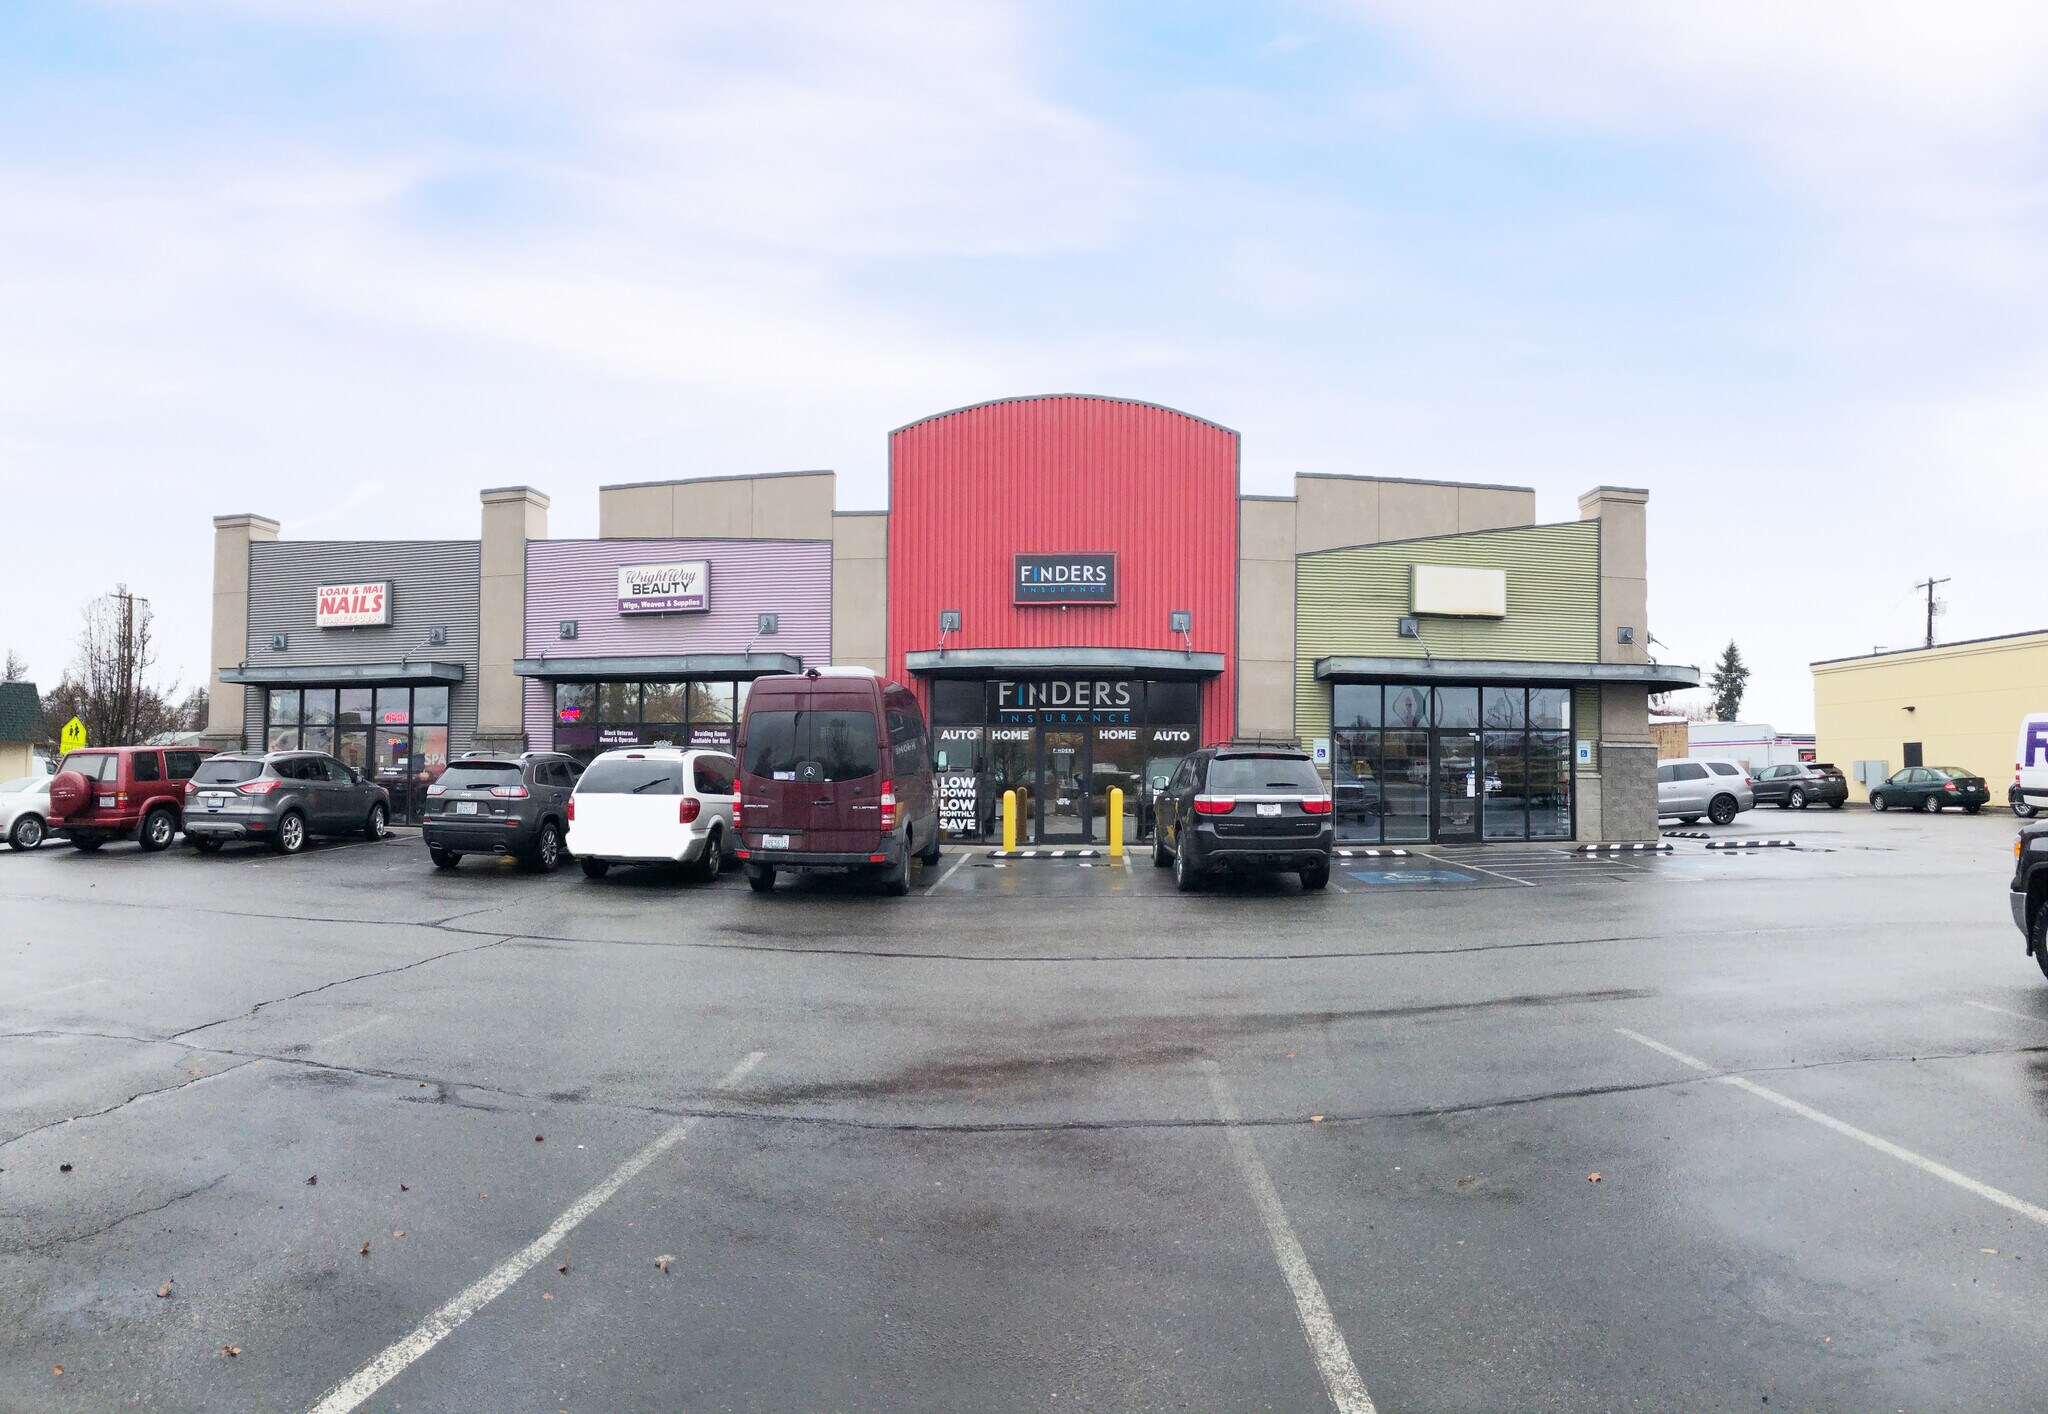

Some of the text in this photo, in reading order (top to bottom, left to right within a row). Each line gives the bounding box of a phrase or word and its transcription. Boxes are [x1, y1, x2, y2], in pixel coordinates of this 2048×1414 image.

[1021, 565, 1106, 582] FINDERS
[319, 585, 384, 597] LOAN & MAI
[632, 581, 689, 595] BEAUTY
[319, 594, 383, 615] NAILS
[622, 601, 640, 610] Wigs,
[641, 600, 665, 608] Weaves
[673, 598, 700, 608] Supplies
[999, 681, 1131, 706] FINDERS
[384, 712, 409, 723] OPEN
[1000, 713, 1130, 723] INSURANCE
[941, 730, 977, 740] AUTO
[992, 730, 1029, 740] HOME
[1099, 730, 1136, 740] HOME
[1153, 731, 1190, 741] AUTO
[2025, 721, 2048, 767] F
[424, 752, 447, 766] SPA
[940, 777, 976, 788] LOW
[940, 789, 976, 797] DOWN
[940, 799, 975, 810] LOW
[939, 819, 976, 830] SAVE
